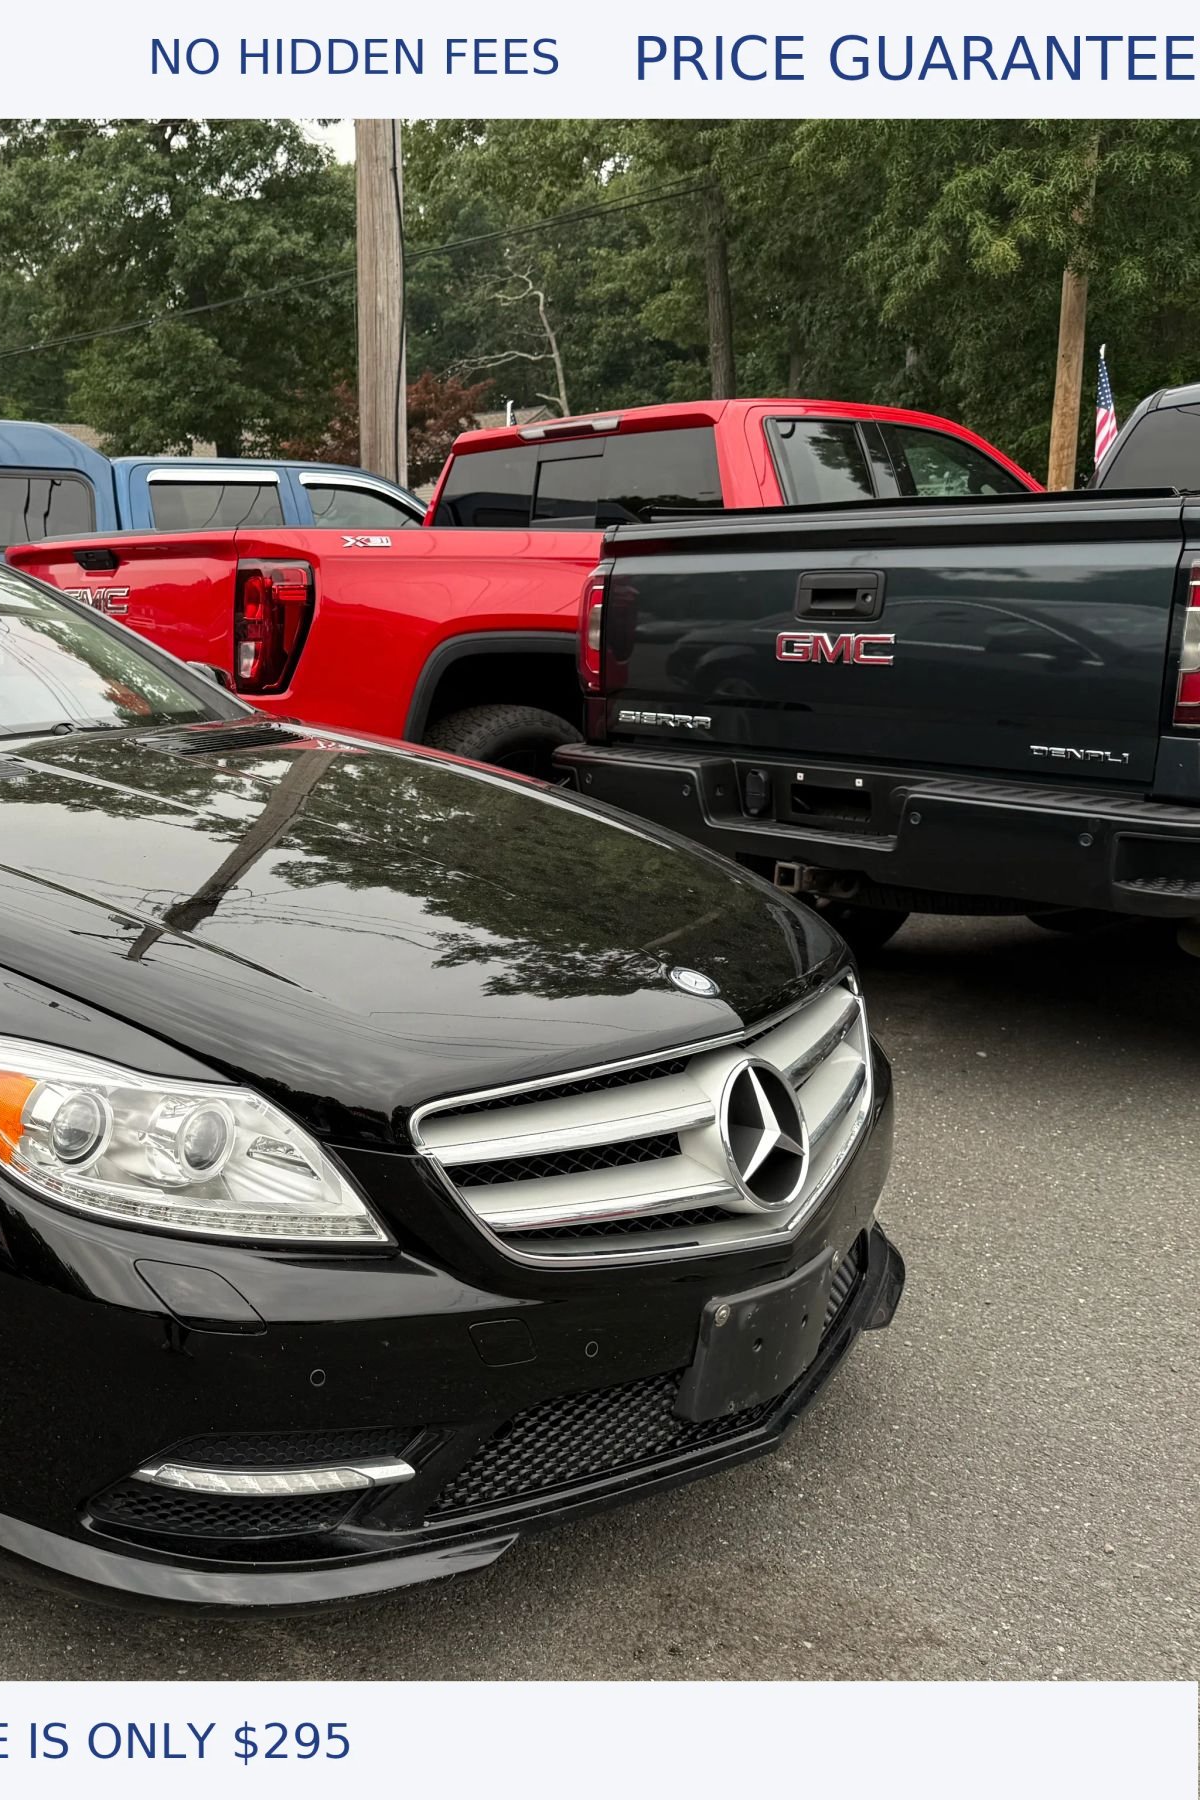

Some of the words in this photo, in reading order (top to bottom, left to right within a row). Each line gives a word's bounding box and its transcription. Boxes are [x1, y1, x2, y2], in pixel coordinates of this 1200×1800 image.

[776, 632, 896, 666] GMC
[619, 710, 712, 729] SIERRA
[1029, 745, 1130, 764] DENALI
